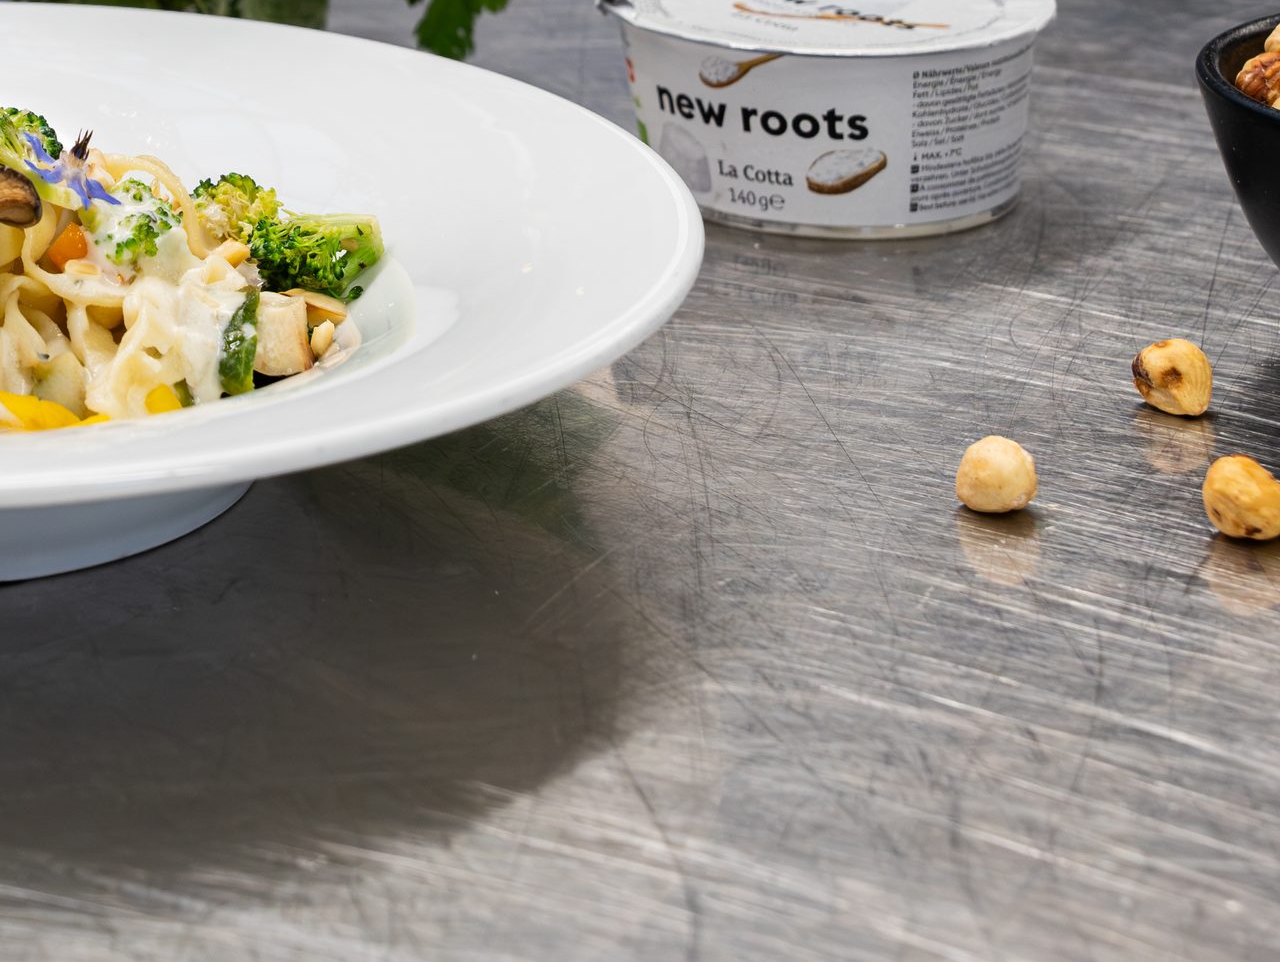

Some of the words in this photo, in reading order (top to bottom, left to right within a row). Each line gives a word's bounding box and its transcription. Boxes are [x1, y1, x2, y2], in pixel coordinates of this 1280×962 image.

[655, 84, 727, 128] new
[740, 107, 869, 141] roots
[717, 158, 739, 179] La
[742, 164, 794, 187] Cotta
